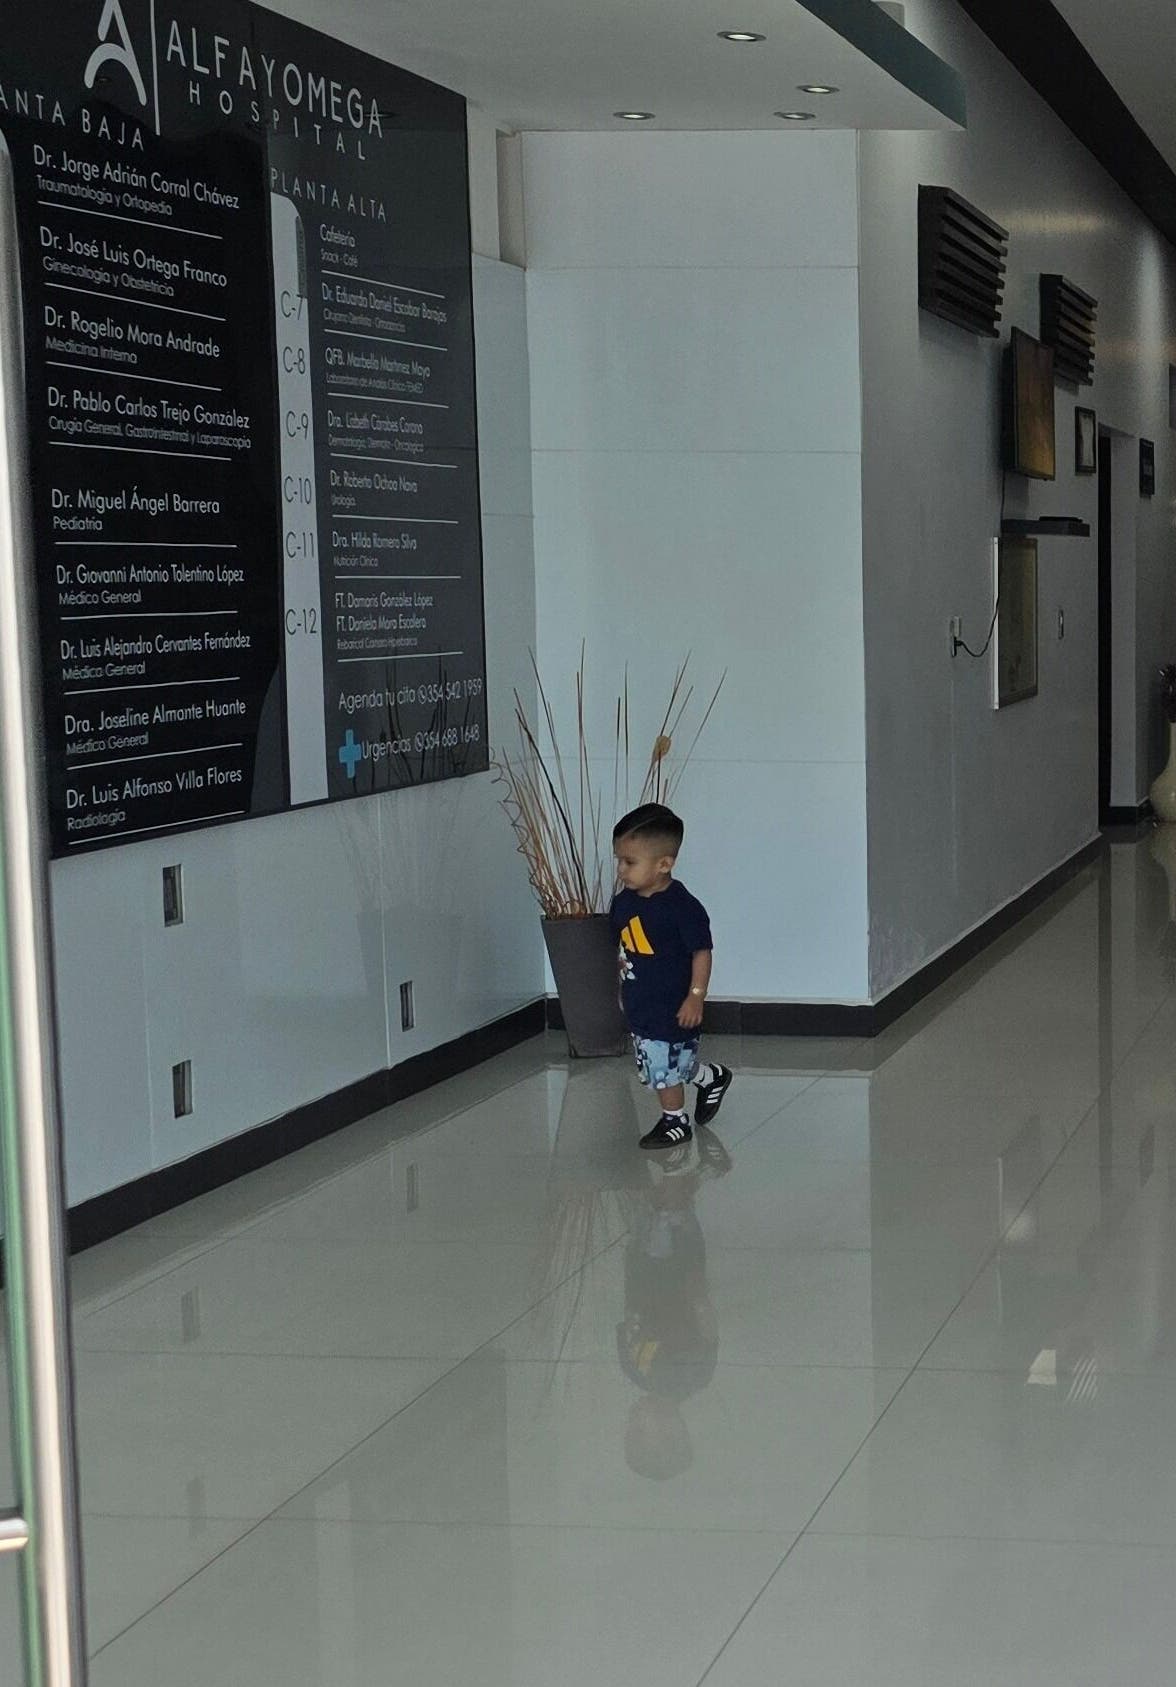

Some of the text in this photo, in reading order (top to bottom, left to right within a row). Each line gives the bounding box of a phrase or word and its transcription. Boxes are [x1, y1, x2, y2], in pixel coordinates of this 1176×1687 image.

[82, 109, 144, 152] BAJA
[190, 80, 365, 160] HOSPITAL
[34, 145, 239, 208] Dr. Jorge Adrián Corral Chávez
[271, 168, 386, 222] PLANTA ALTA
[40, 226, 227, 287] Dr. José Luis Ortega Franco
[113, 275, 118, 288] y
[281, 290, 304, 320] C-7
[45, 306, 220, 357] Dr. Rogelio Mora Andrade
[46, 336, 137, 364] Medicina Interna
[283, 346, 305, 374] C-8
[48, 387, 249, 429] Dr. Pablo Carlos Trejo González
[328, 410, 343, 427] Dra.
[286, 411, 308, 439] C-9
[284, 476, 311, 504] C-10
[330, 470, 341, 487] Dr.
[52, 486, 219, 515] Dr. Miguel Ángel Barrera
[286, 532, 314, 558] C-11
[332, 531, 349, 547] Dra.
[351, 531, 371, 548] Hilda
[57, 564, 244, 586] Dr. Giovanni Antonio Tolentino López
[59, 589, 141, 605] Médico General
[286, 609, 316, 635] C-12
[60, 630, 250, 660] Dr. Luis Alejandro Cervantes Fernández
[62, 661, 145, 680] Médico General
[339, 692, 383, 714] Agenda
[386, 692, 394, 706] tu
[397, 687, 415, 704] cita
[428, 684, 442, 703] 354
[65, 715, 94, 734] Dra.
[99, 708, 149, 731] Joseline
[206, 699, 246, 718] Huante
[66, 732, 148, 755] Médico General
[363, 738, 411, 762] Urgencias
[67, 767, 242, 808] Dr. Luis Alfonso Villa Flores
